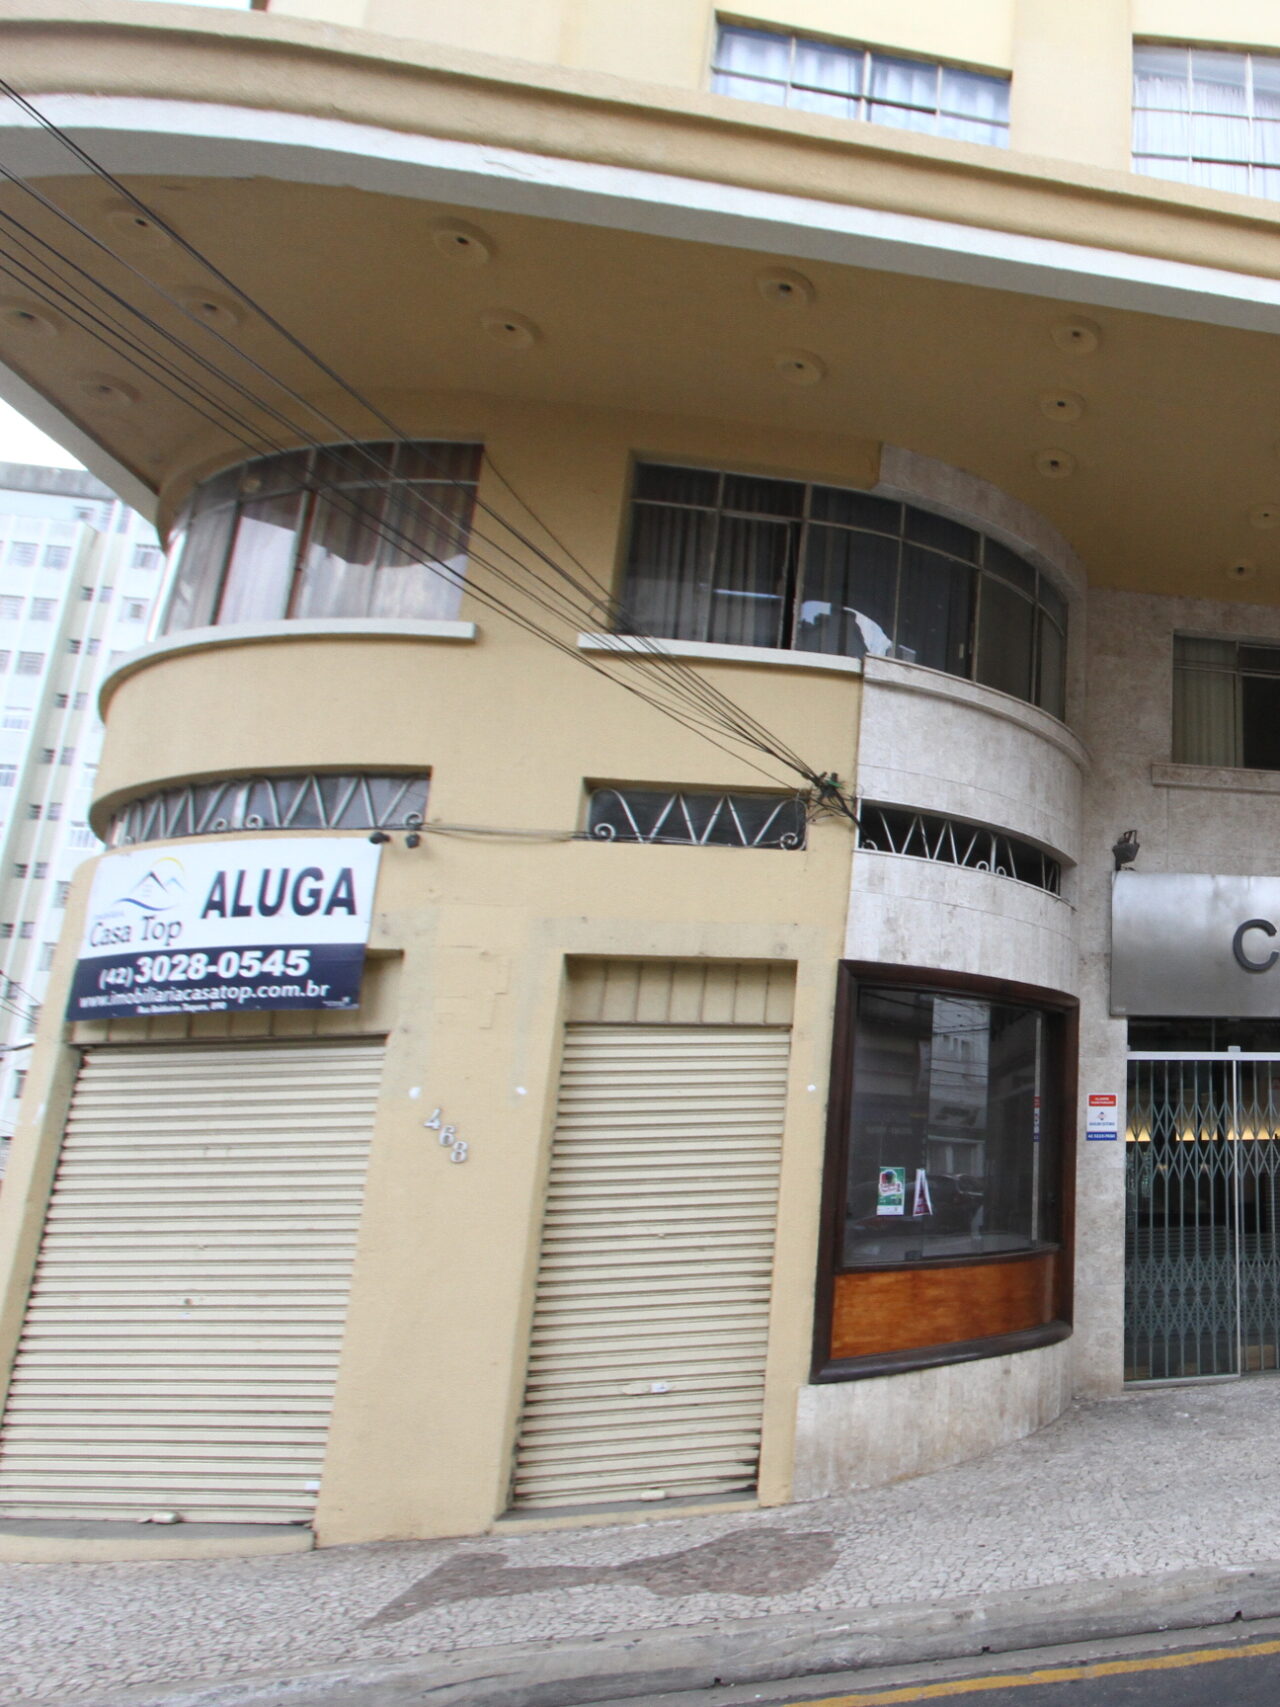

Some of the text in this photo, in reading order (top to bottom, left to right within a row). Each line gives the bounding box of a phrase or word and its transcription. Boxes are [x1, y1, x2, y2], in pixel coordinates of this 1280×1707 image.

[200, 867, 357, 919] ALUGA
[90, 915, 182, 948] Casa Top
[98, 950, 310, 989] (42) 3028-0545
[79, 979, 330, 1008] www.imobiliariacasatop.com.br
[423, 1107, 469, 1164] 468
